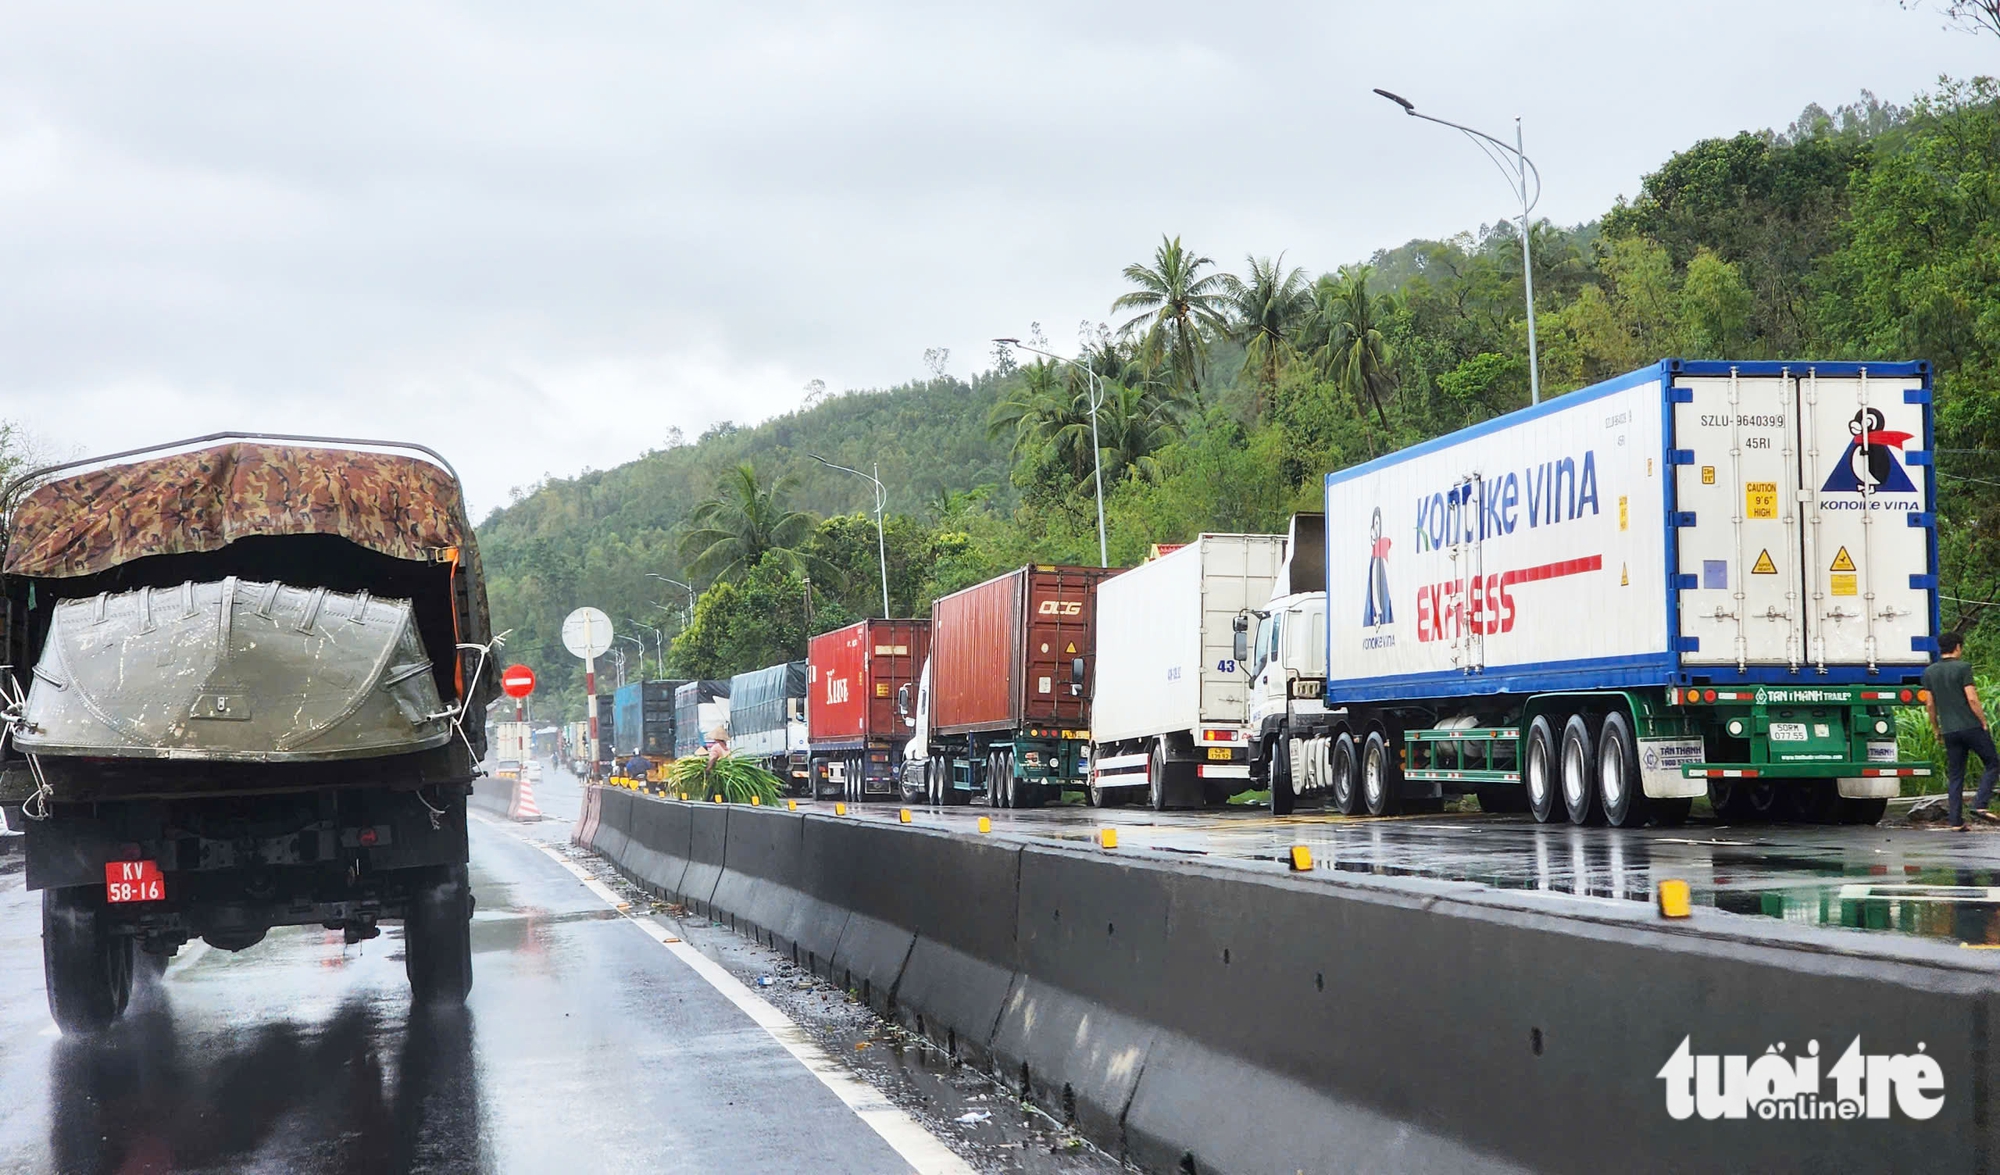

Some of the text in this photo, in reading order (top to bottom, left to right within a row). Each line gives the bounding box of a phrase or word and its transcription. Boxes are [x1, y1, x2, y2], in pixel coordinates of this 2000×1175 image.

[1747, 483, 1777, 493] CAUTION
[1753, 508, 1772, 518] HIGH
[123, 862, 143, 881] KV
[110, 881, 159, 902] 58-16
